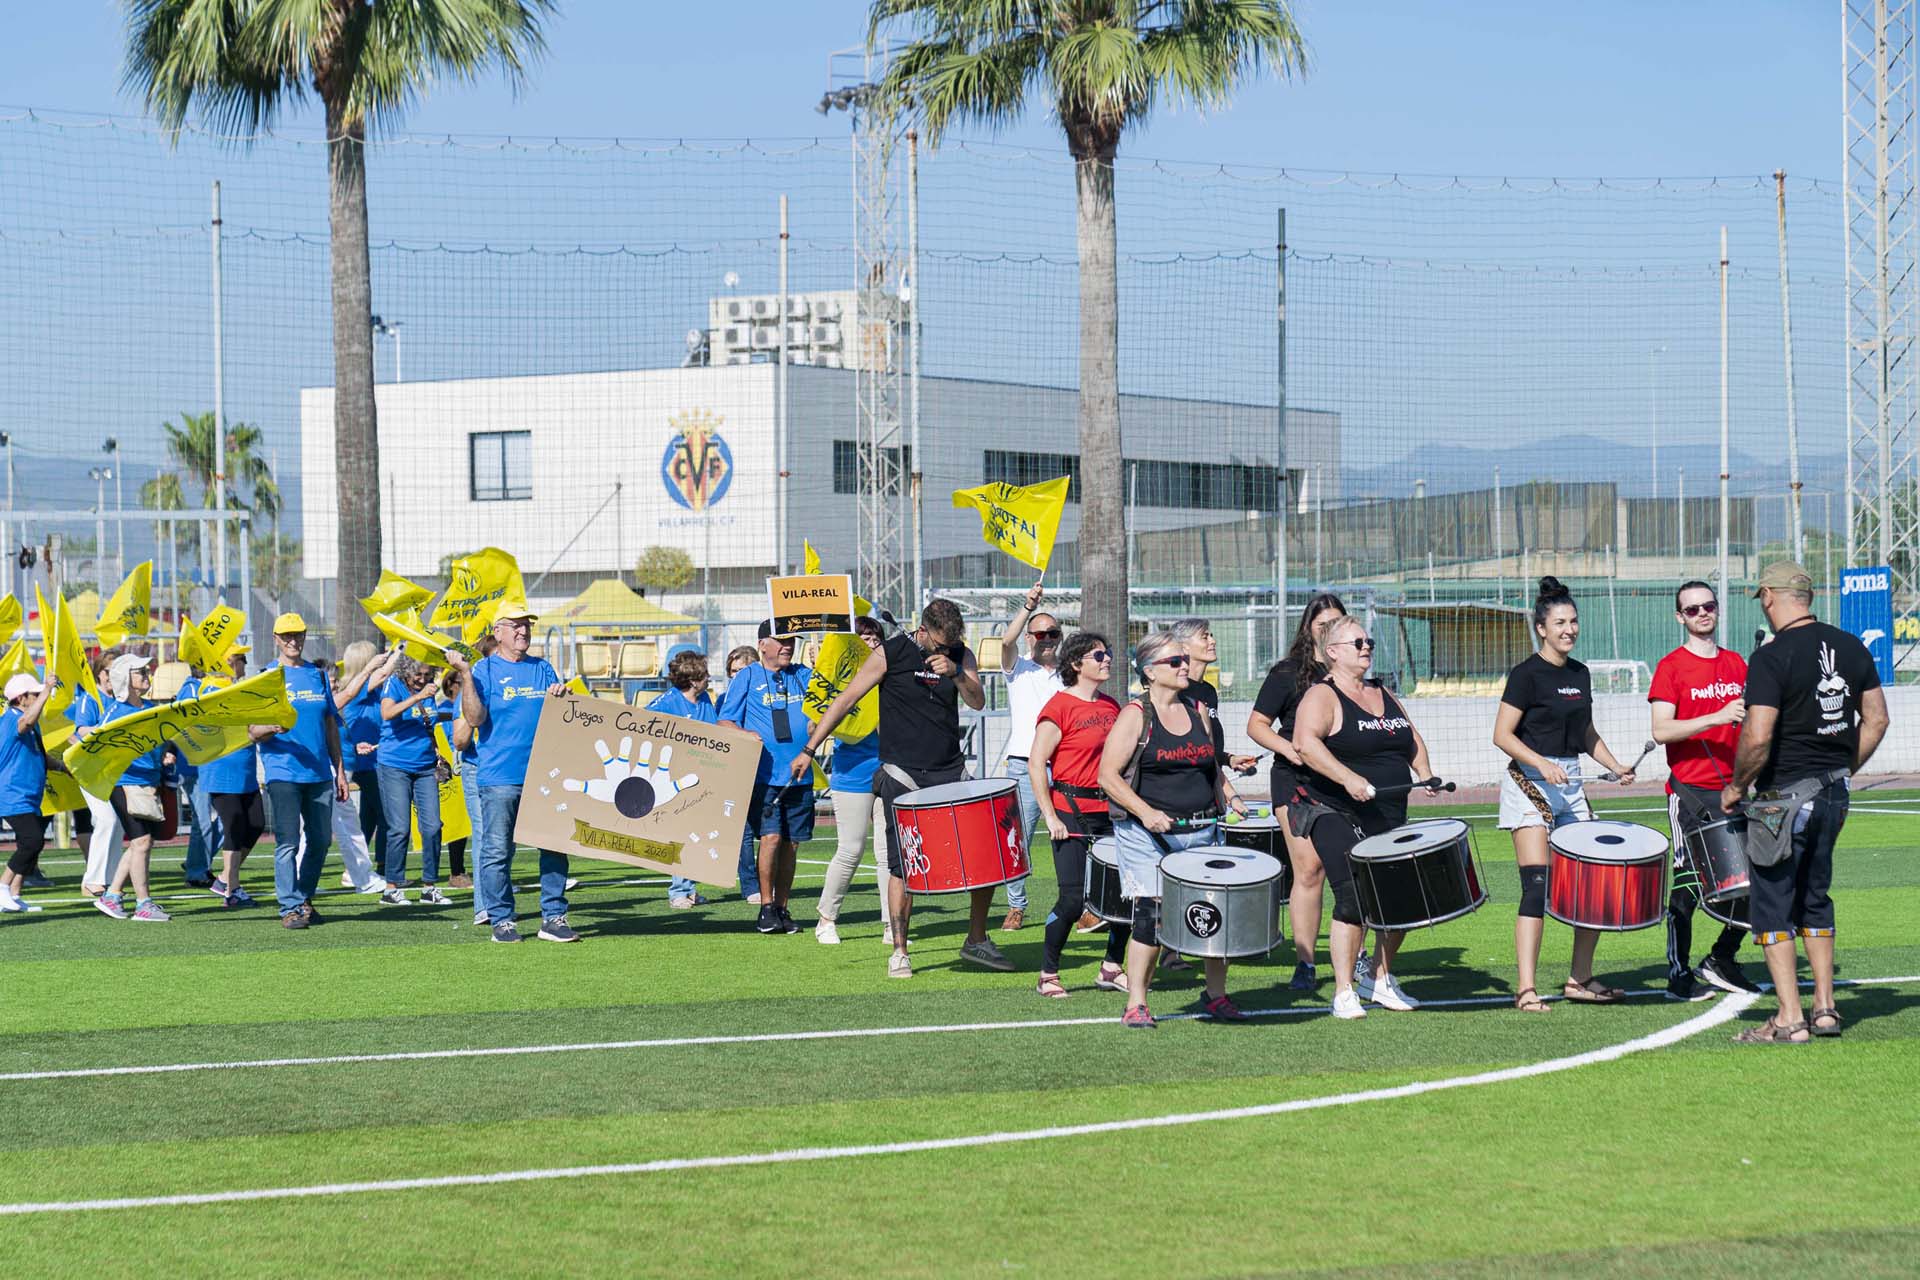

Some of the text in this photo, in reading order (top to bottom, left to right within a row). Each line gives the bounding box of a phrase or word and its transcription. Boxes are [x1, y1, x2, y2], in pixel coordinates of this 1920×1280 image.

[782, 588, 839, 599] VILA-REAL
[562, 700, 731, 754] Juegos Castellonenses
[583, 829, 667, 858] VILA-REAL 2026
